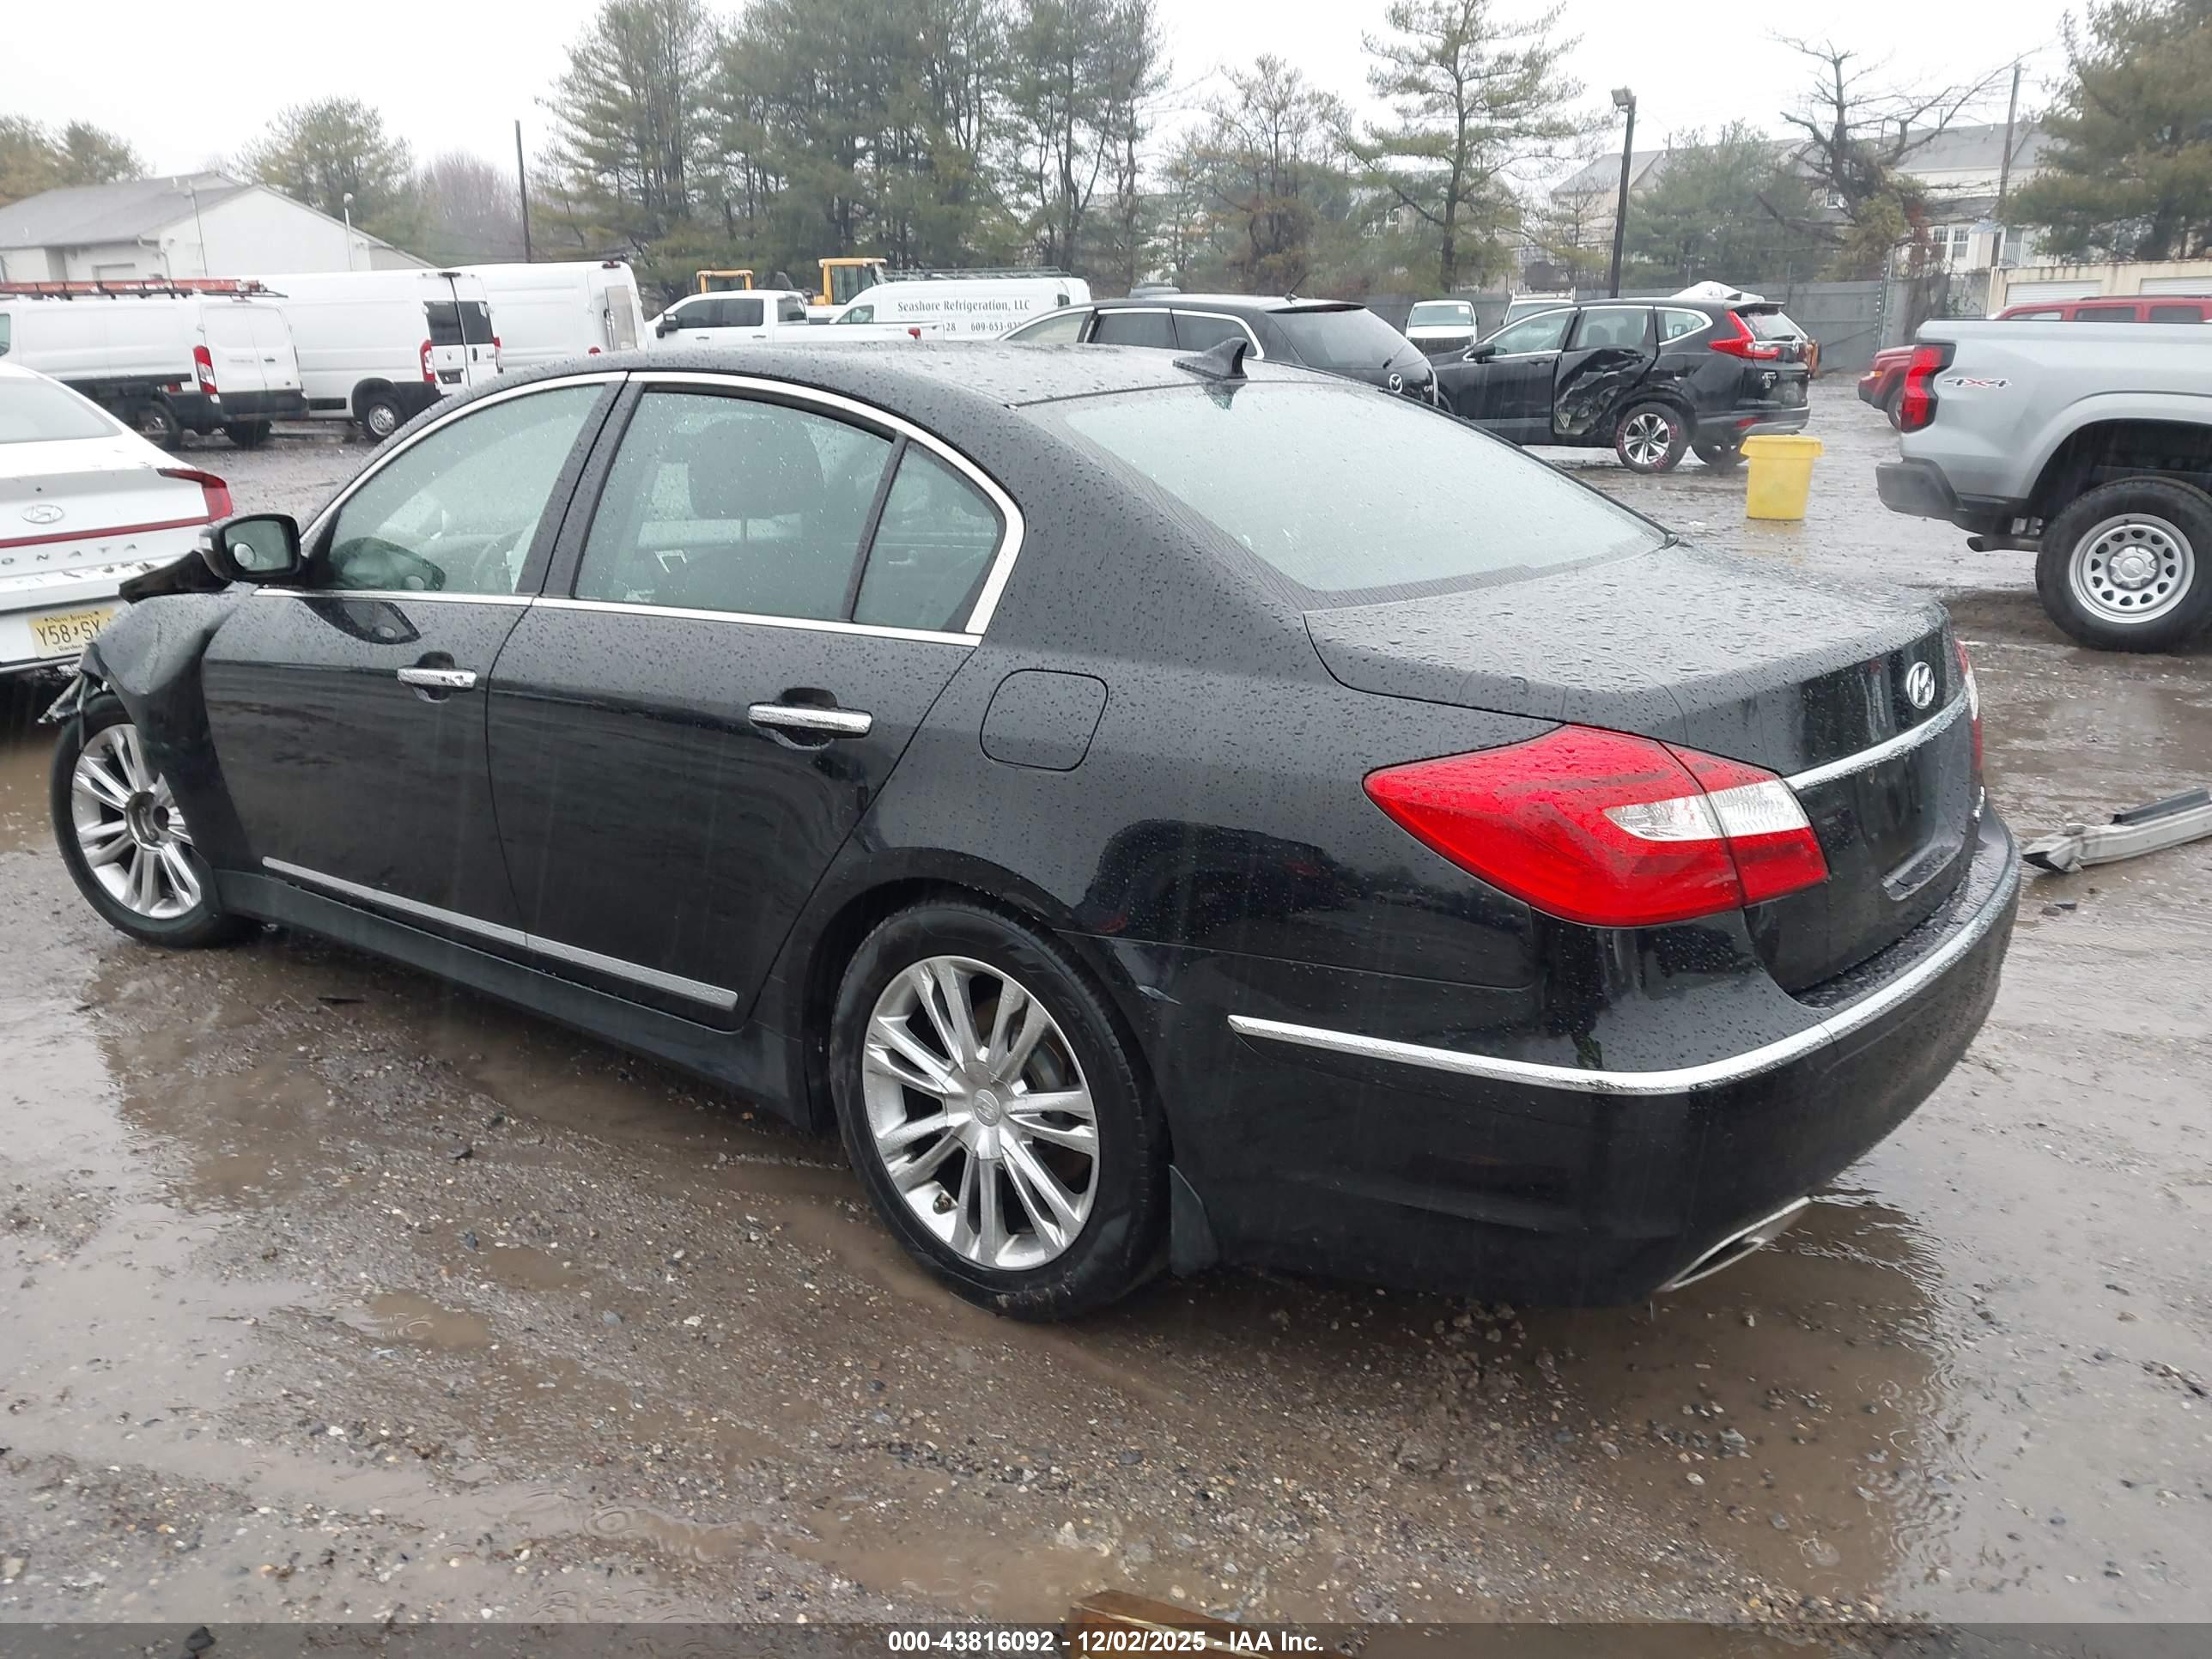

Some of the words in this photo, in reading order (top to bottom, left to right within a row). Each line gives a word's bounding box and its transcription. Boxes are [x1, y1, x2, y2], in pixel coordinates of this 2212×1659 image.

[897, 300, 940, 312] Seashore
[944, 299, 1011, 313] Refrigeration,
[1014, 300, 1030, 310] LLC
[970, 321, 1021, 331] 609-653-93
